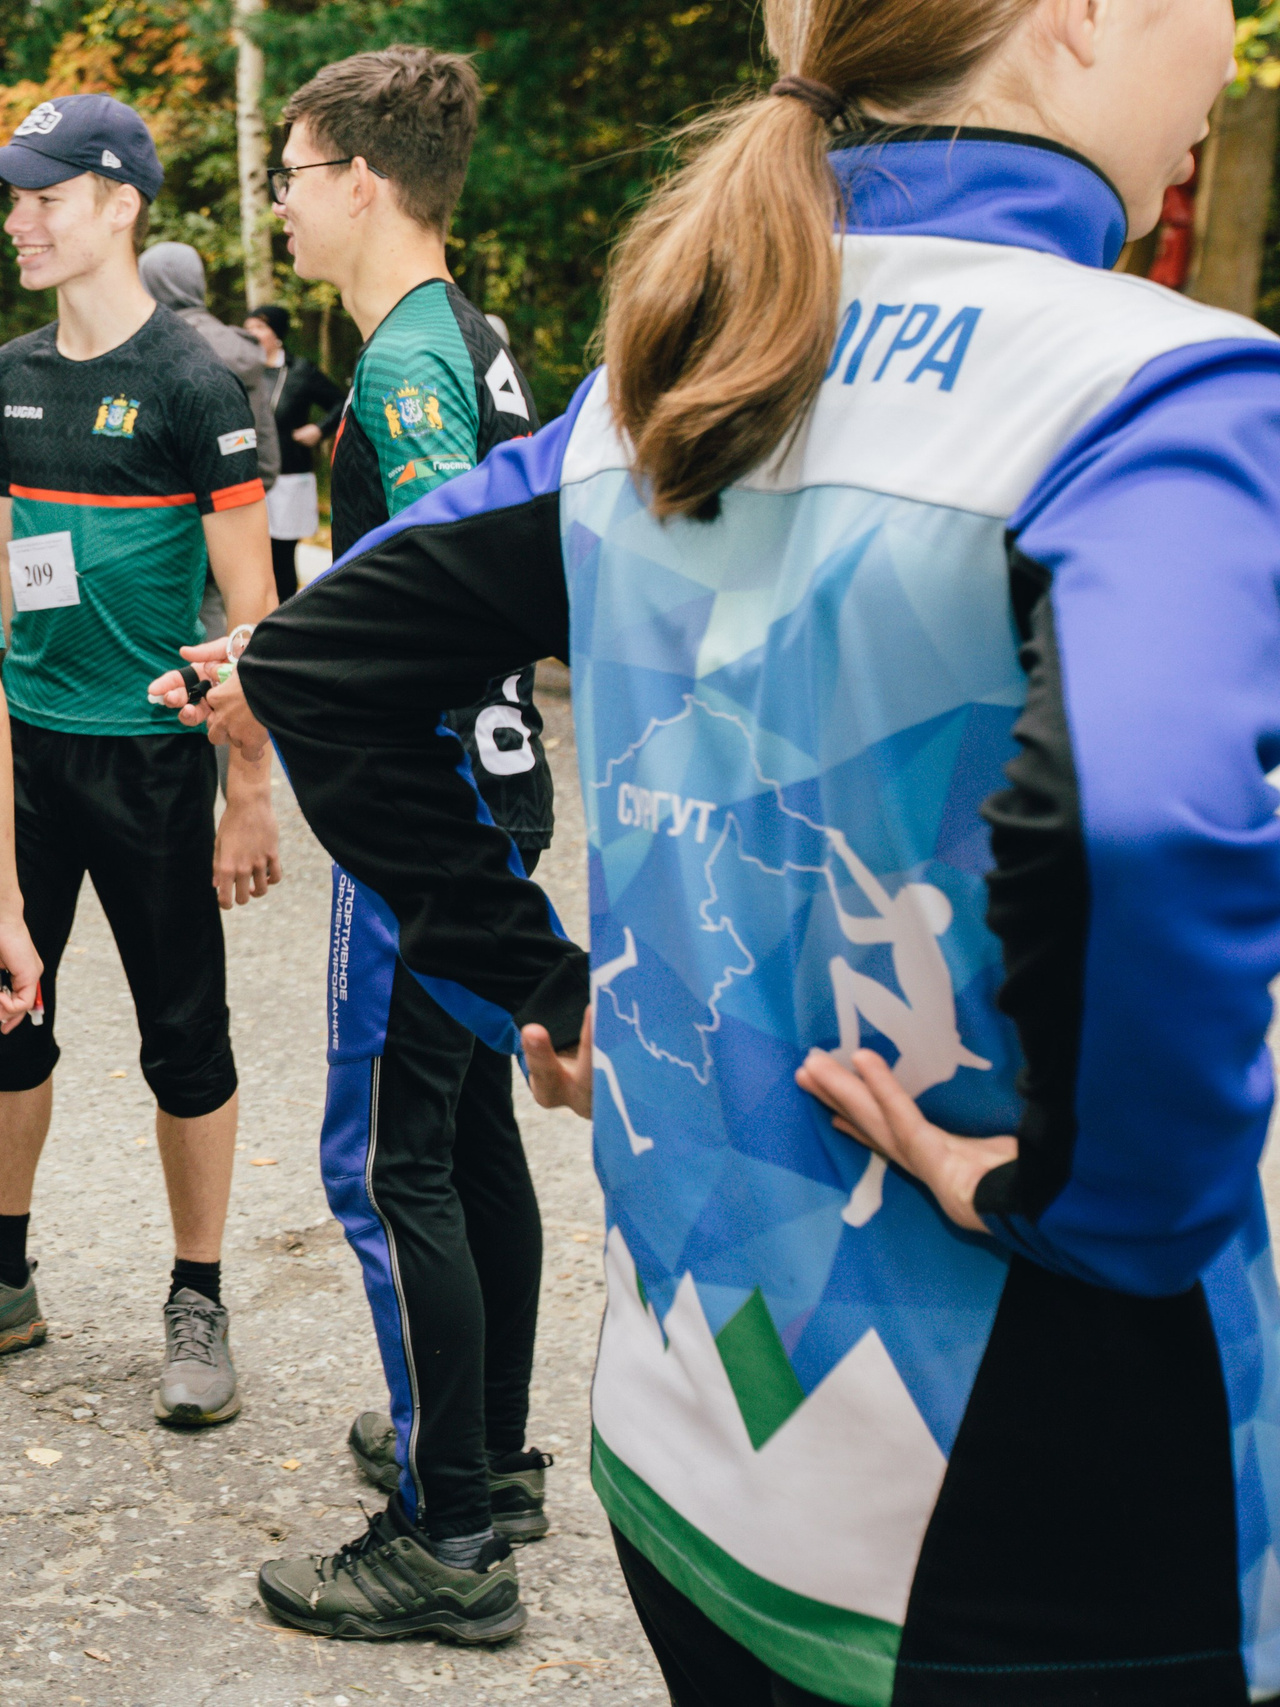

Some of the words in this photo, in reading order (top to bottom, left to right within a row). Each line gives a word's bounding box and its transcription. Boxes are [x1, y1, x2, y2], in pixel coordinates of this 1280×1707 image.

[4, 405, 43, 420] O-UGRA
[25, 562, 53, 587] 209
[331, 874, 347, 1051] ОРИЕНТИРОВАНИЕ
